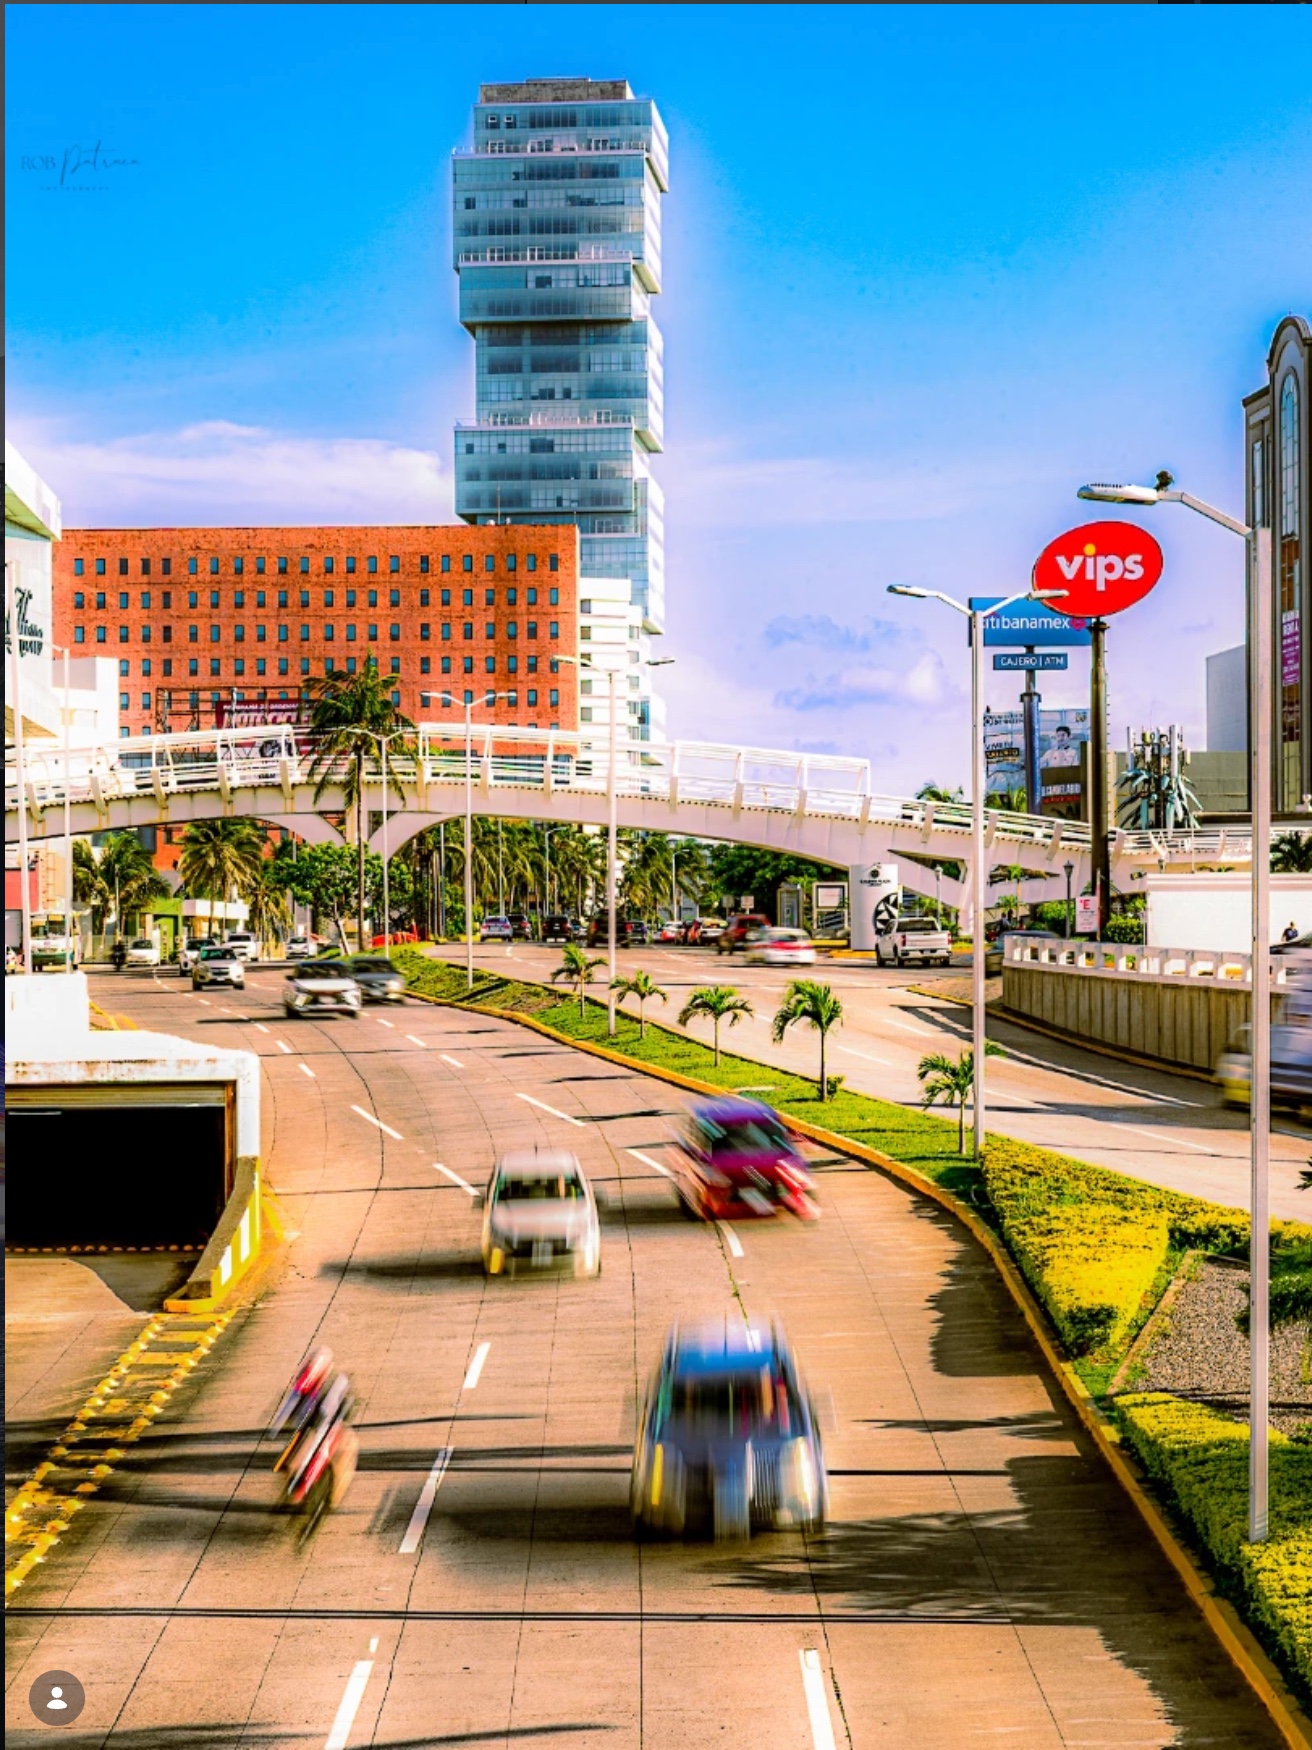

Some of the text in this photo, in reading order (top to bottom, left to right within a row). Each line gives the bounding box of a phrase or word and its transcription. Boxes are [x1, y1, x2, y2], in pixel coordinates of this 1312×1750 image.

[1055, 543, 1145, 592] vips
[983, 615, 1070, 629] itibanamex
[1000, 655, 1064, 667] CAJERO ATM
